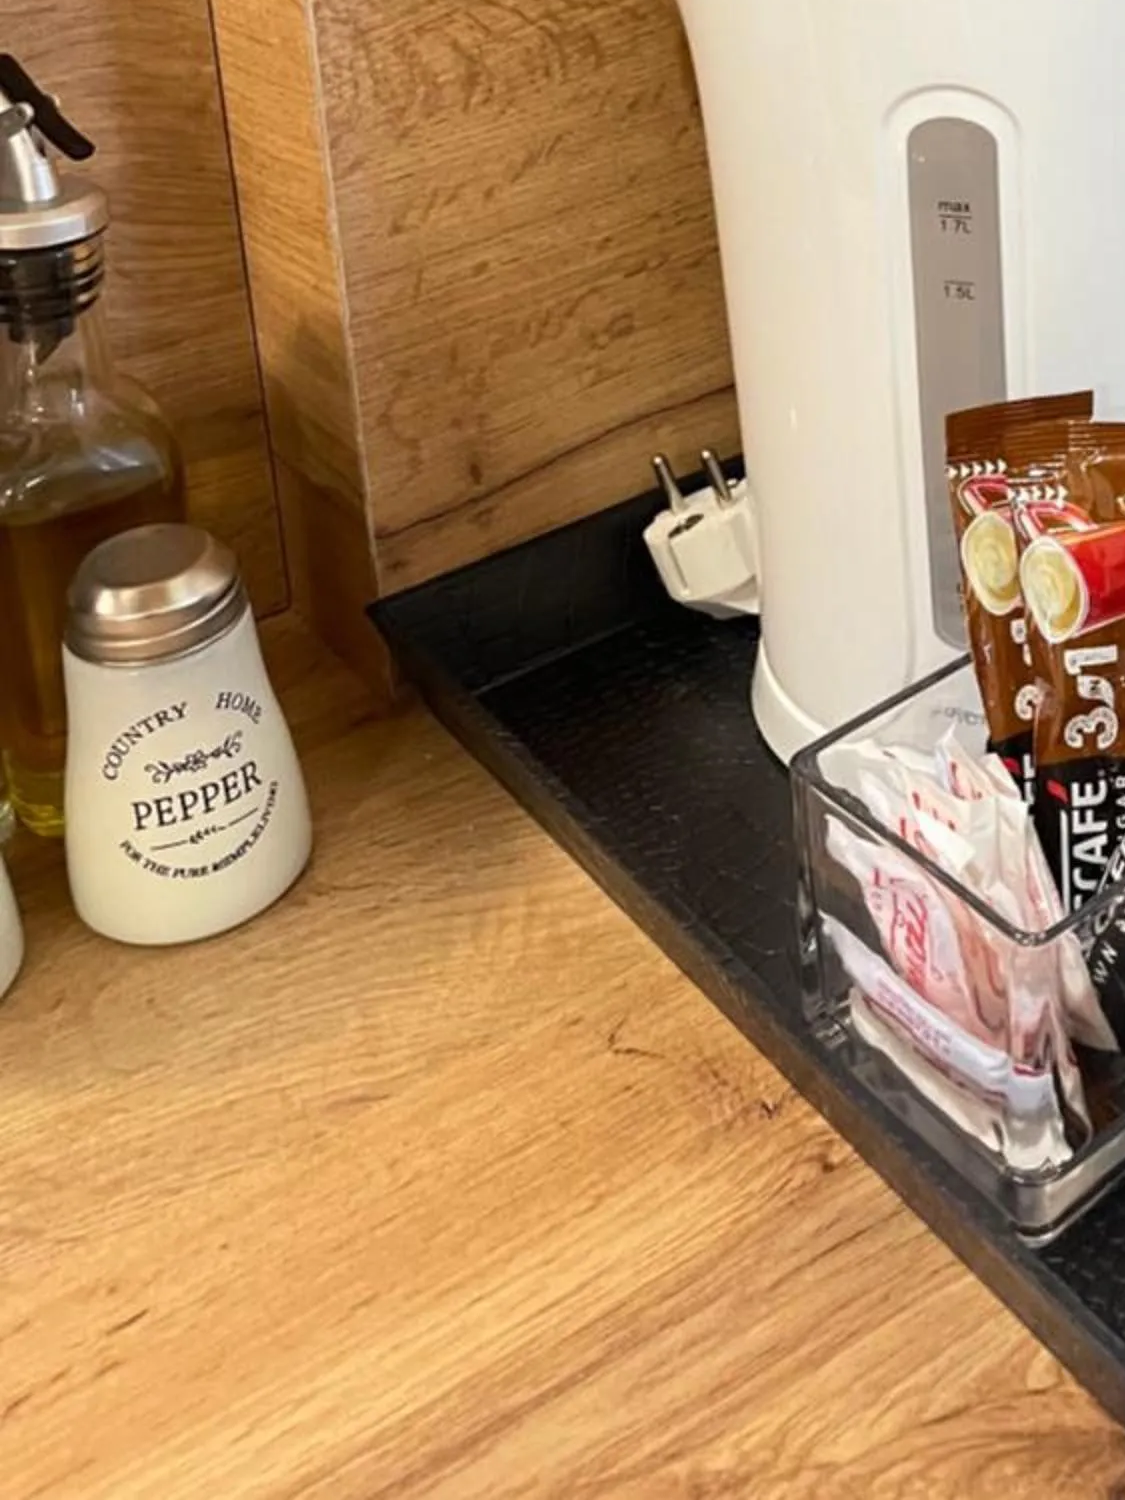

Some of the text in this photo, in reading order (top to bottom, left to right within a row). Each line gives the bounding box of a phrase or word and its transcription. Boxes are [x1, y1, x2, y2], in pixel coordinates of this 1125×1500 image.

[938, 201, 971, 212] max
[940, 218, 972, 234] 17L
[943, 284, 975, 300] 15L
[102, 691, 262, 781] COUNTRY HOME
[132, 760, 262, 831] PEPPER
